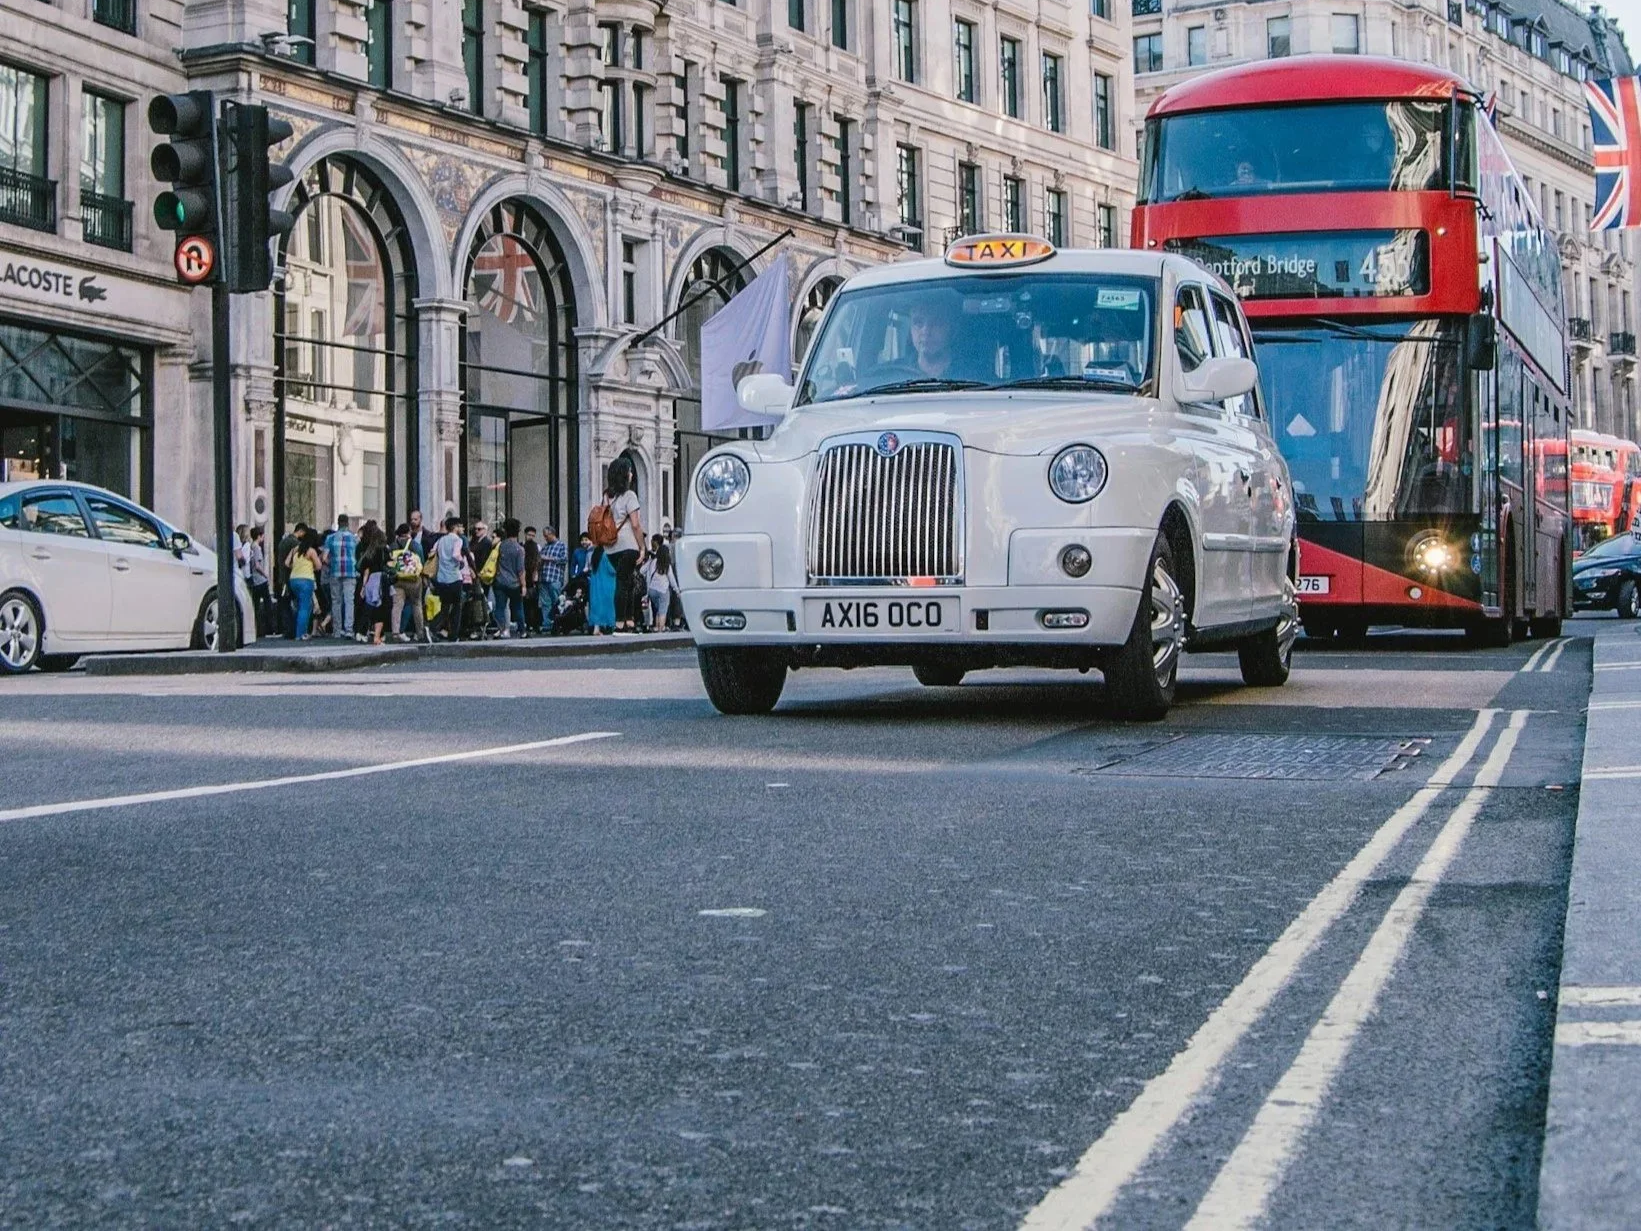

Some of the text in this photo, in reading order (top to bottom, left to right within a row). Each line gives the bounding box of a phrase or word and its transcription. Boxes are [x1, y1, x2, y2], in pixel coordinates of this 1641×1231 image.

[965, 242, 1026, 261] TAXI
[1267, 254, 1315, 278] Bridge
[0, 262, 73, 296] ACOSTE
[821, 601, 942, 628] AX16 OCO
